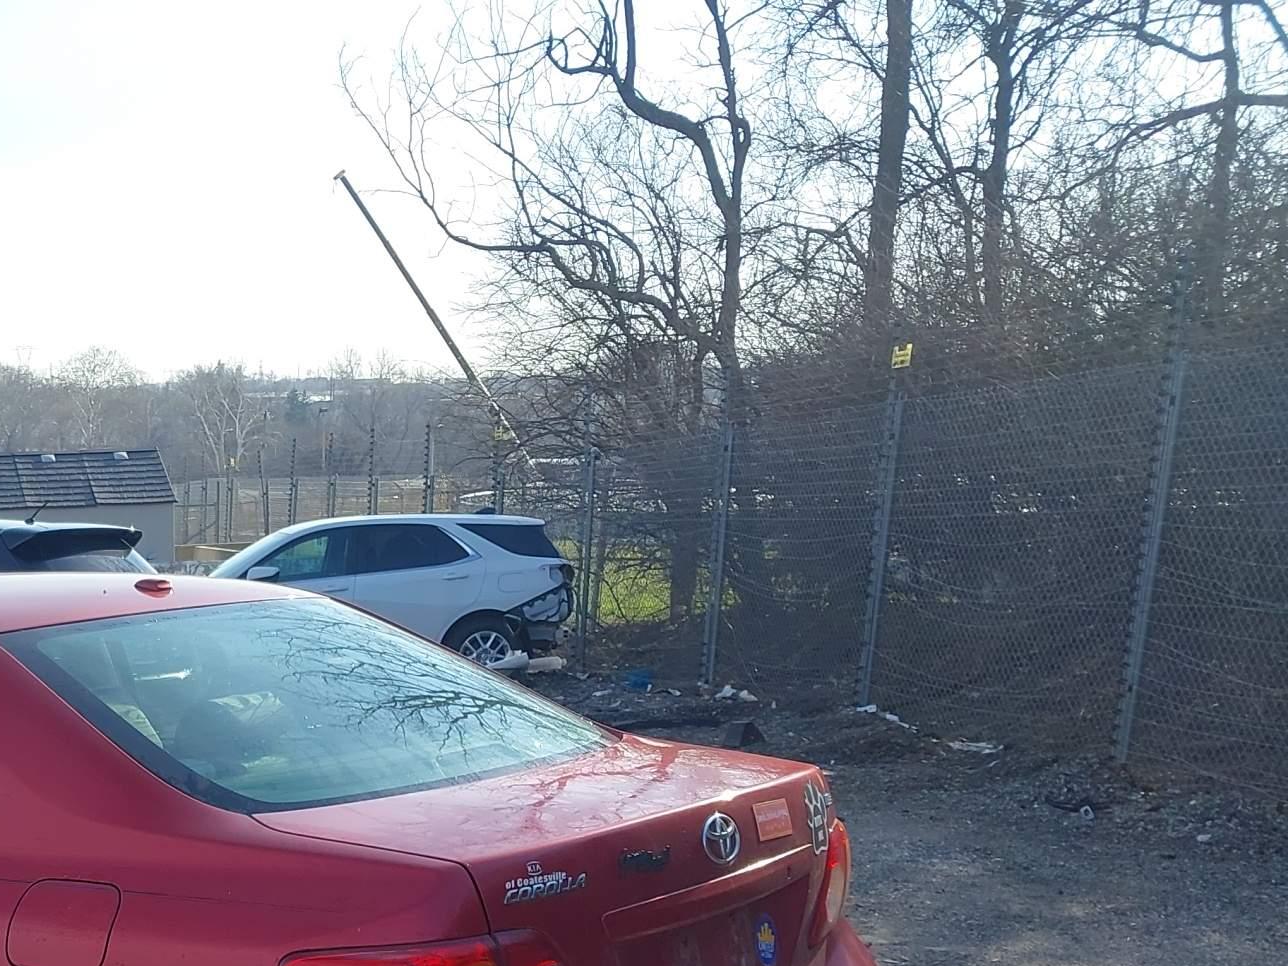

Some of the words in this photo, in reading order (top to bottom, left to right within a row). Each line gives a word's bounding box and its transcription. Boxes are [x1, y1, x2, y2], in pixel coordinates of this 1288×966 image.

[527, 864, 542, 873] KIA
[517, 872, 566, 887] Coatesville
[503, 873, 586, 905] COROLLA
